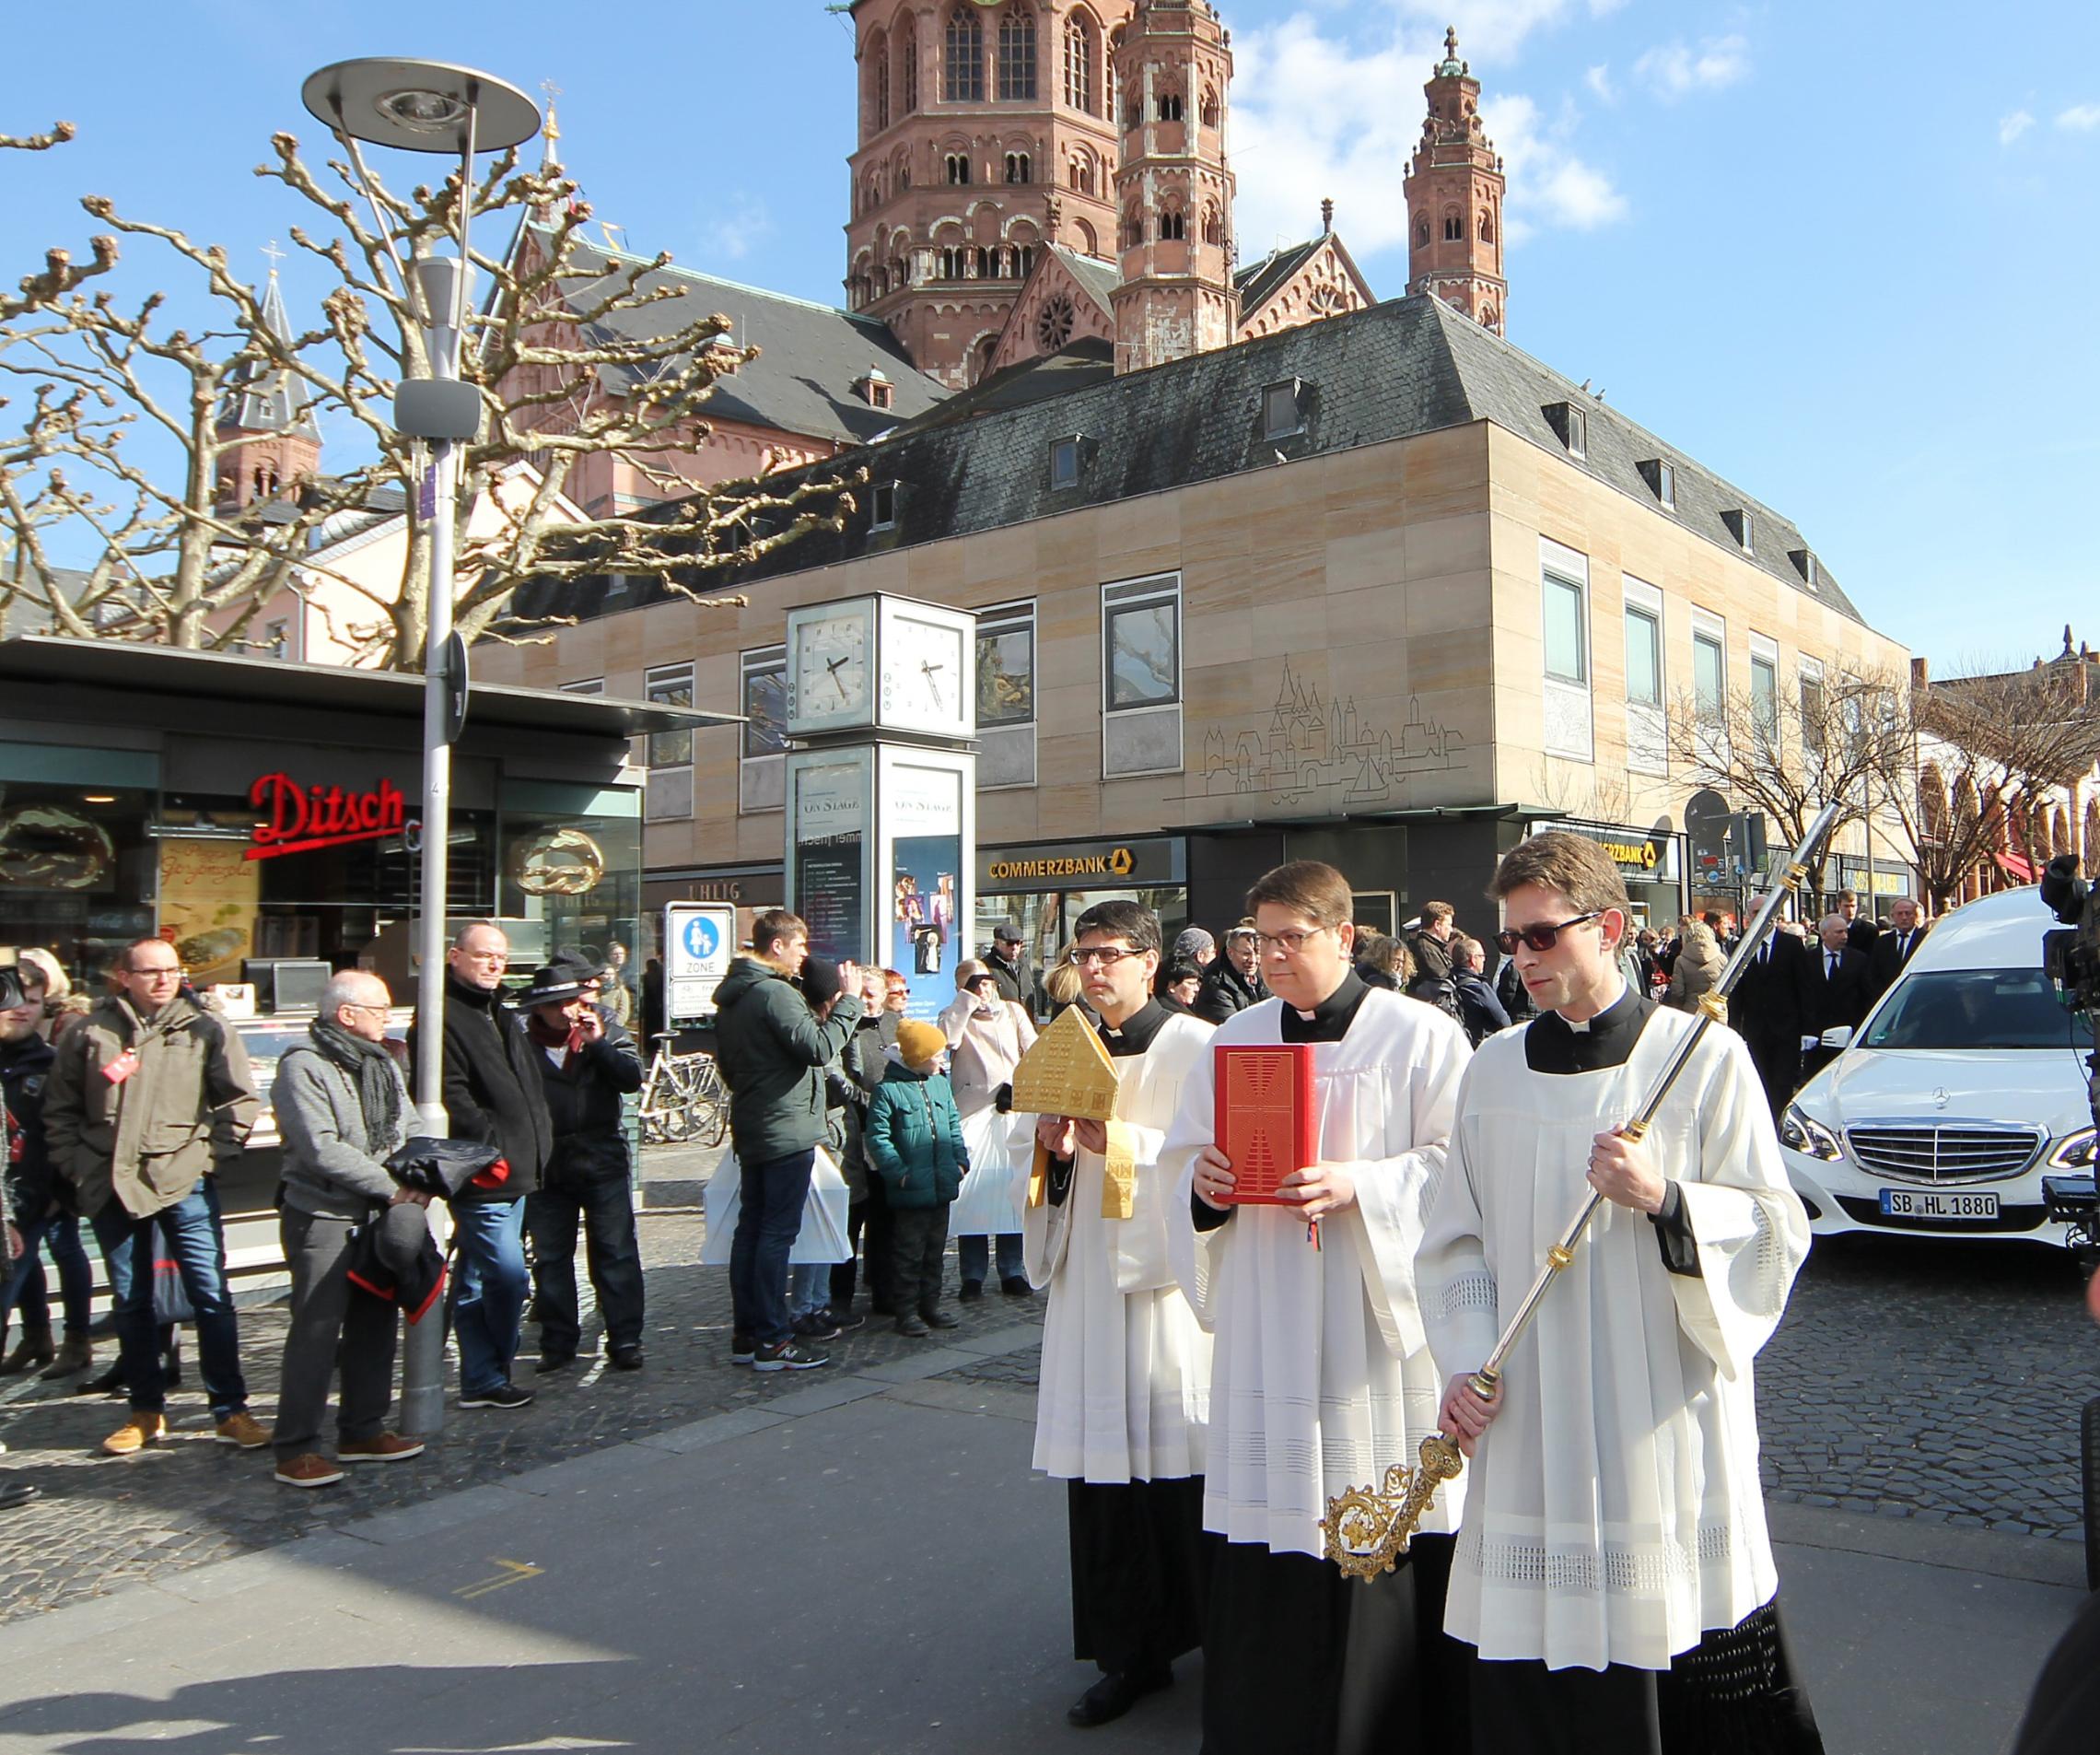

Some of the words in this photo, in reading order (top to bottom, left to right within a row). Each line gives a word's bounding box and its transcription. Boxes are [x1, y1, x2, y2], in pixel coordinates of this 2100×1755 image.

[251, 772, 404, 842] Ditsch
[1599, 842, 1643, 864] ERZBANK
[988, 857, 1105, 878] COMMERZBANK
[689, 883, 740, 900] UHLIG
[686, 962, 715, 974] ZONE
[1892, 1195, 1912, 1212] SB
[1925, 1196, 1946, 1214] HL
[1951, 1198, 1995, 1215] 1880
